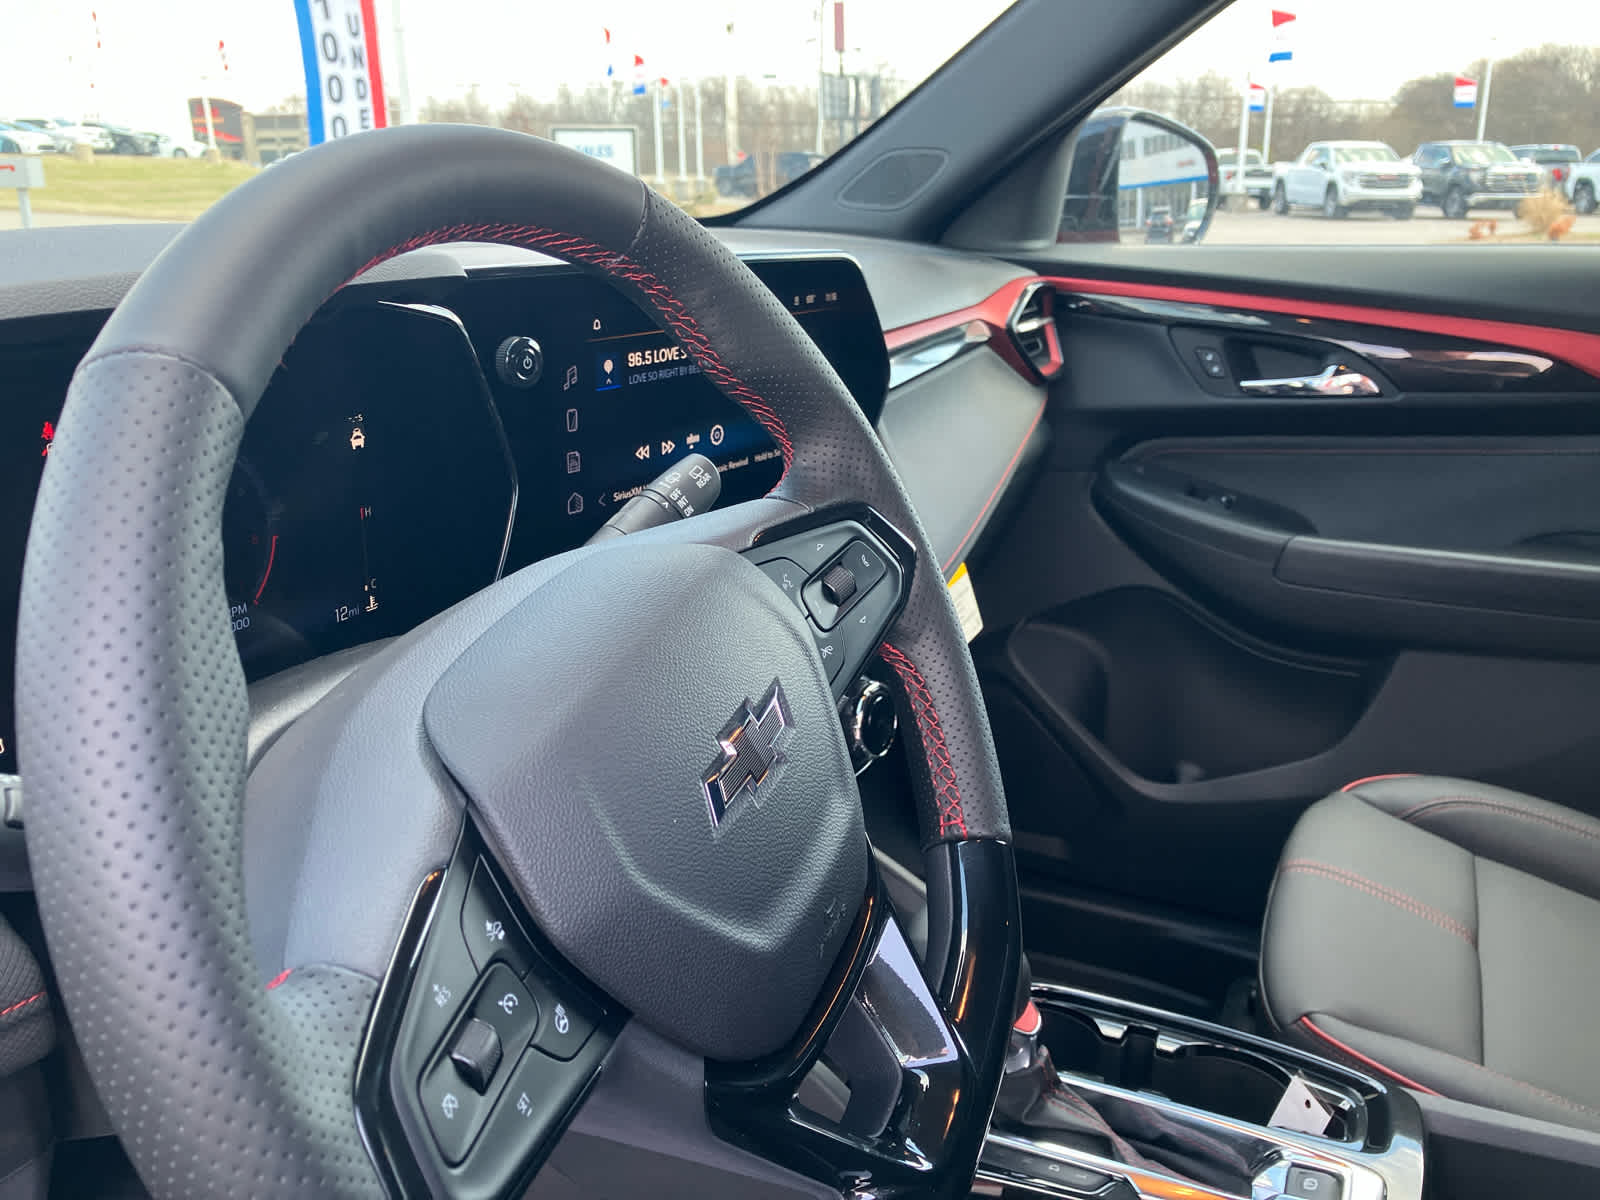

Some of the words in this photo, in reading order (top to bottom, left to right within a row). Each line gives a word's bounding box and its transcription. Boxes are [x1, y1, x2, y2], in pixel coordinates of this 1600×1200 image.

[627, 350, 653, 367] 96.5
[653, 347, 680, 363] LOVE
[628, 372, 648, 385] LOVE
[647, 370, 658, 382] SO
[658, 367, 679, 380] RIGHT
